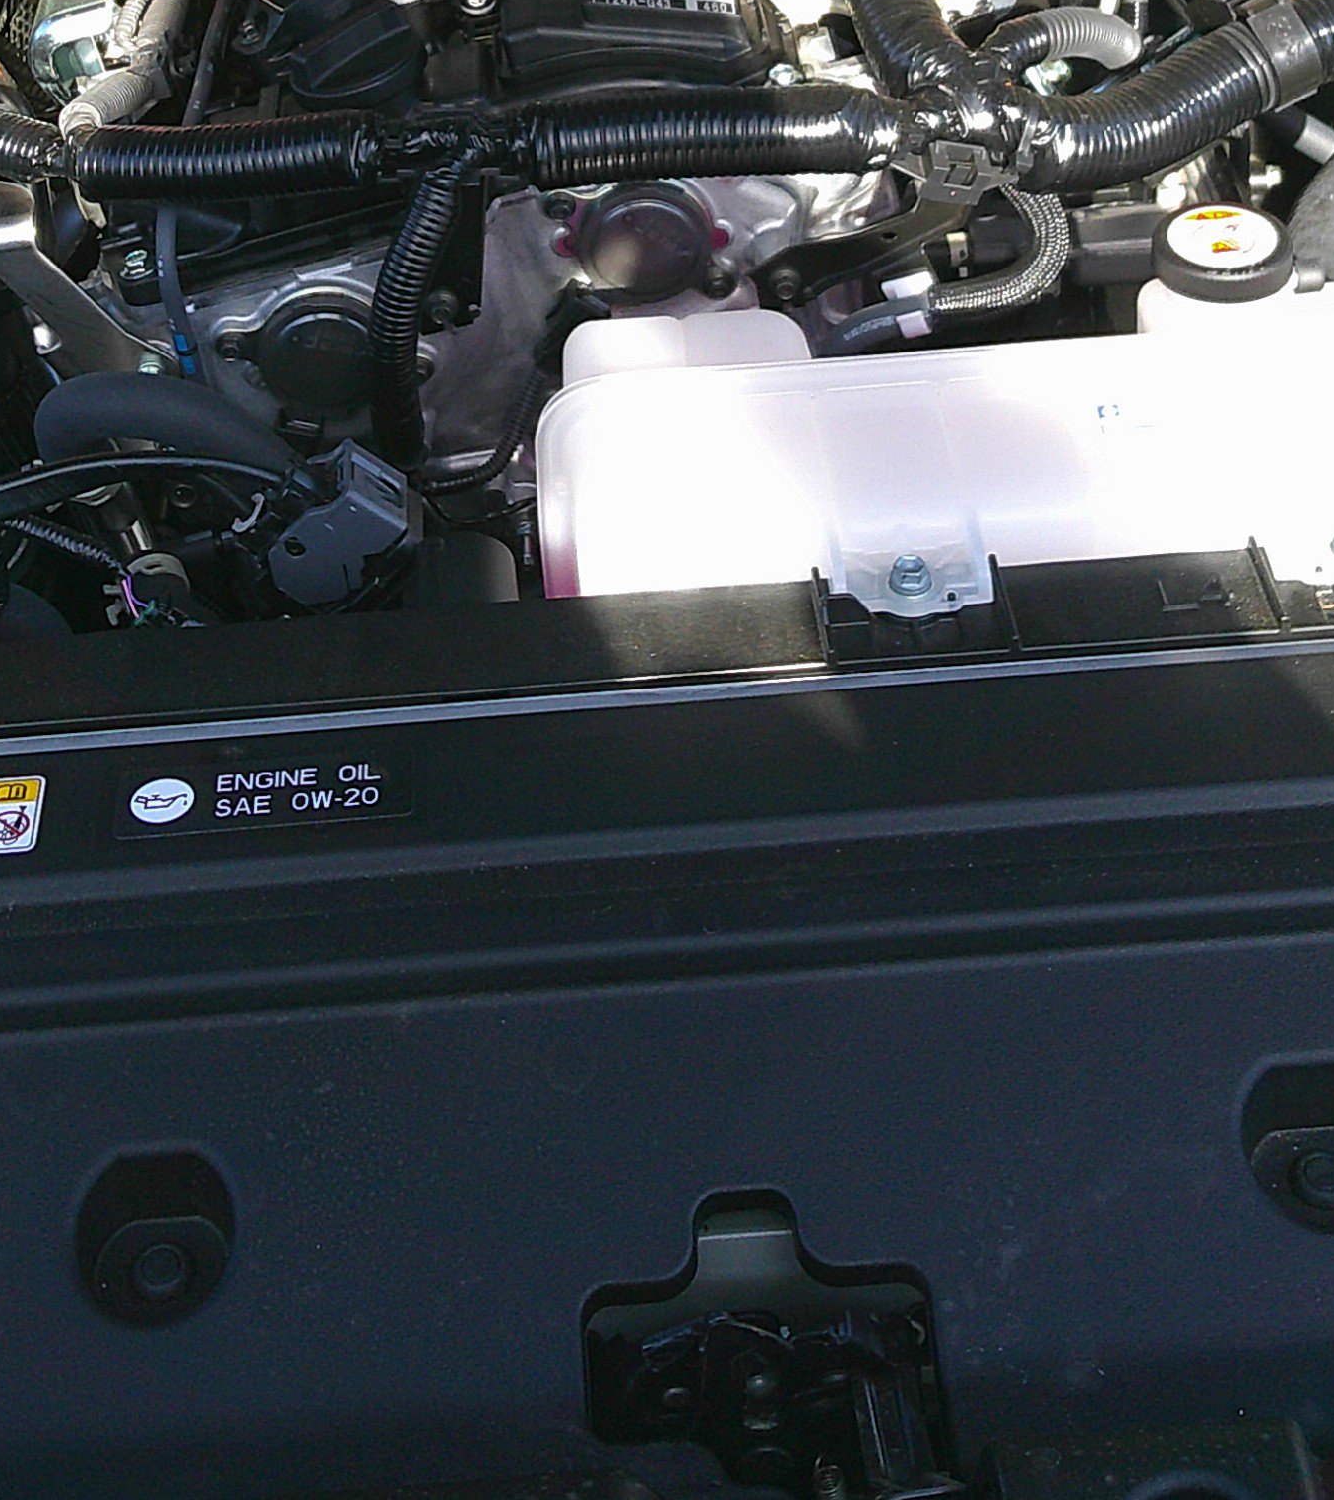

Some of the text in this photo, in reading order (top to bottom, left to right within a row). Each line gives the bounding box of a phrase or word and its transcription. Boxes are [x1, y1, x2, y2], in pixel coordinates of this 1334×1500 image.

[216, 763, 382, 793] ENGINE OIL
[215, 786, 379, 818] SAE 0W-20
